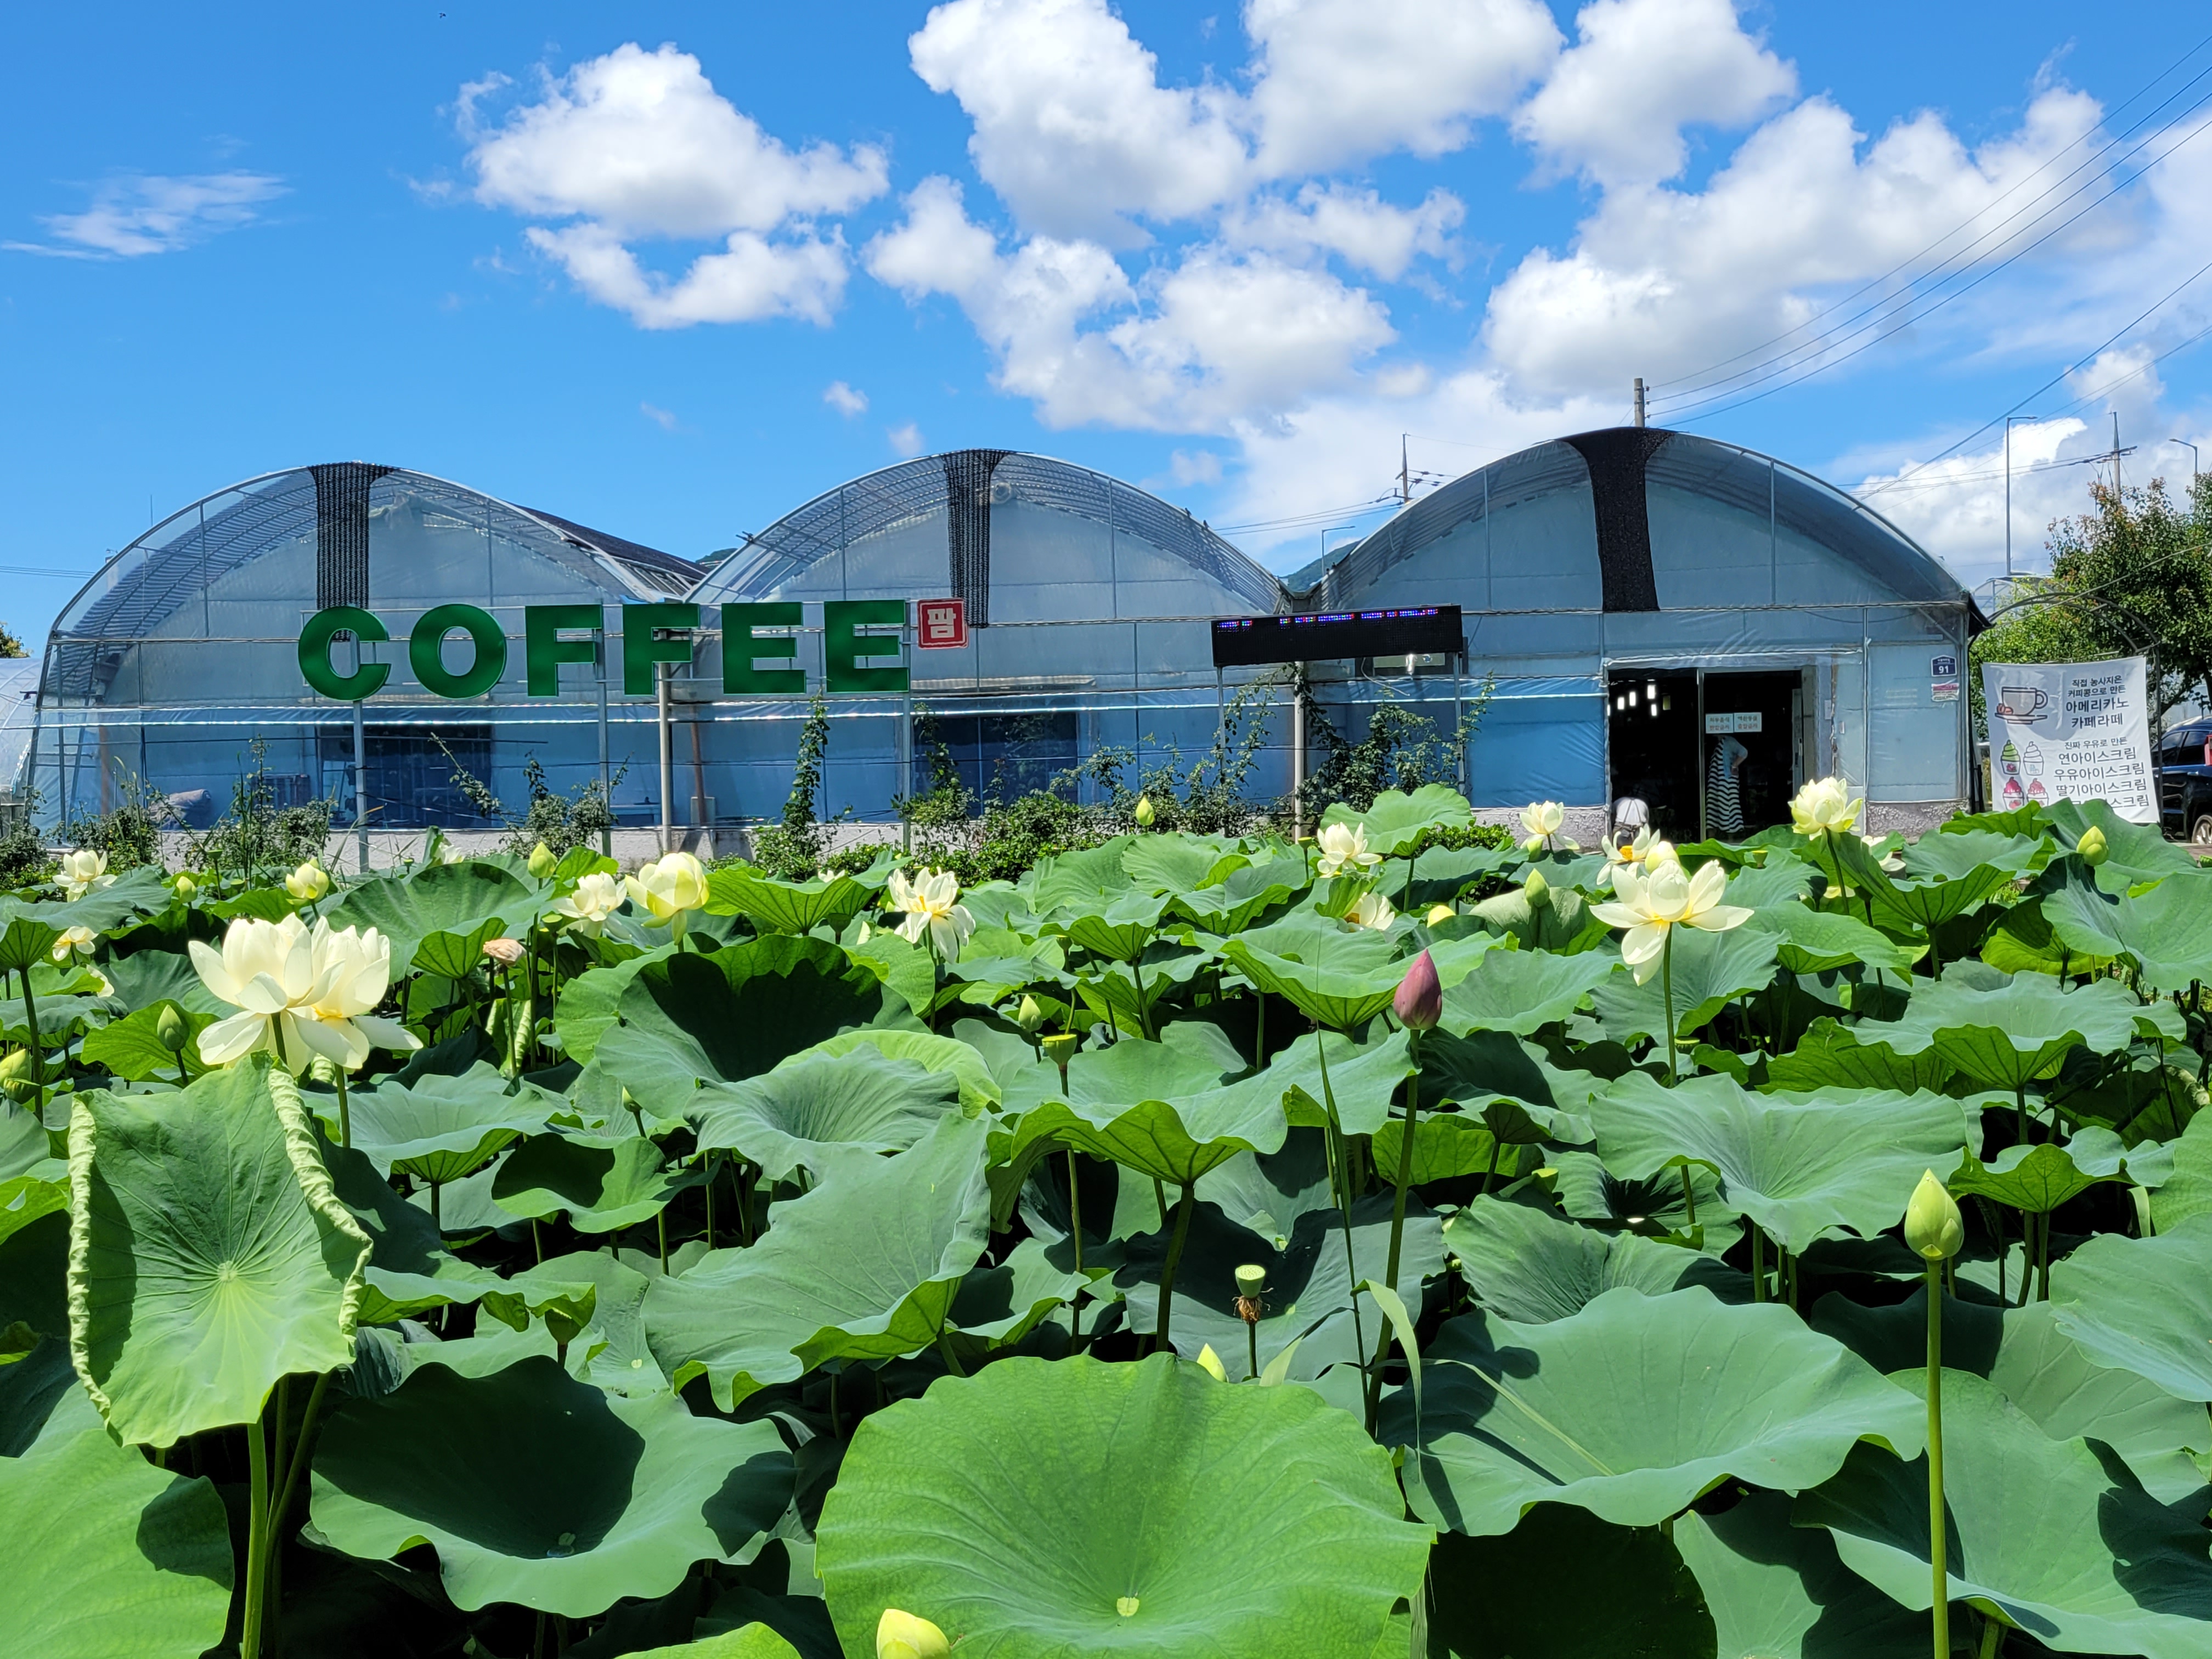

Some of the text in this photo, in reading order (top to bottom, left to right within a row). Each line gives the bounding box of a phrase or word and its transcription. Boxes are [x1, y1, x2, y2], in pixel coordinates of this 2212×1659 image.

[927, 608, 956, 639] 팜
[298, 600, 910, 701] COFFEE
[1938, 665, 1949, 674] 91
[2068, 685, 2126, 698] 커피콩으로 만든
[2072, 679, 2087, 687] 직접
[2066, 697, 2129, 714] 아메리카노
[2071, 712, 2123, 729] 카페라떼
[2064, 737, 2128, 750] 진짜 우유로 만든
[2058, 747, 2136, 765] 연아이스크림
[2053, 762, 2145, 781] 우유아이스크림
[2056, 778, 2147, 797] 딸기아이스크림
